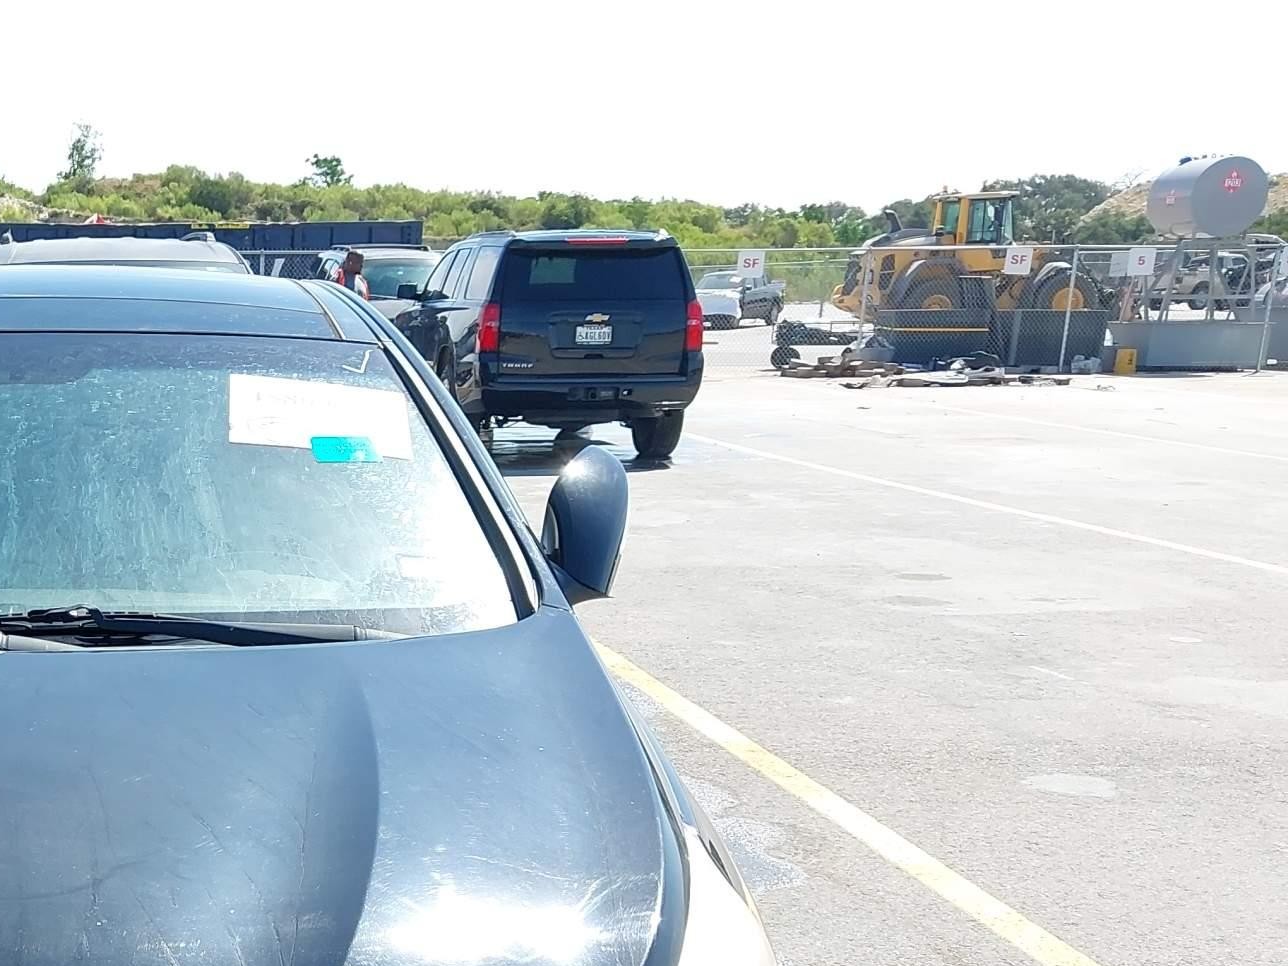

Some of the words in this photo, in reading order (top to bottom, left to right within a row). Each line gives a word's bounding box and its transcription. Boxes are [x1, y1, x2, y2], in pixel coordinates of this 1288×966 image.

[743, 258, 760, 268] SF
[1009, 254, 1028, 265] SF
[1138, 256, 1147, 266] 5
